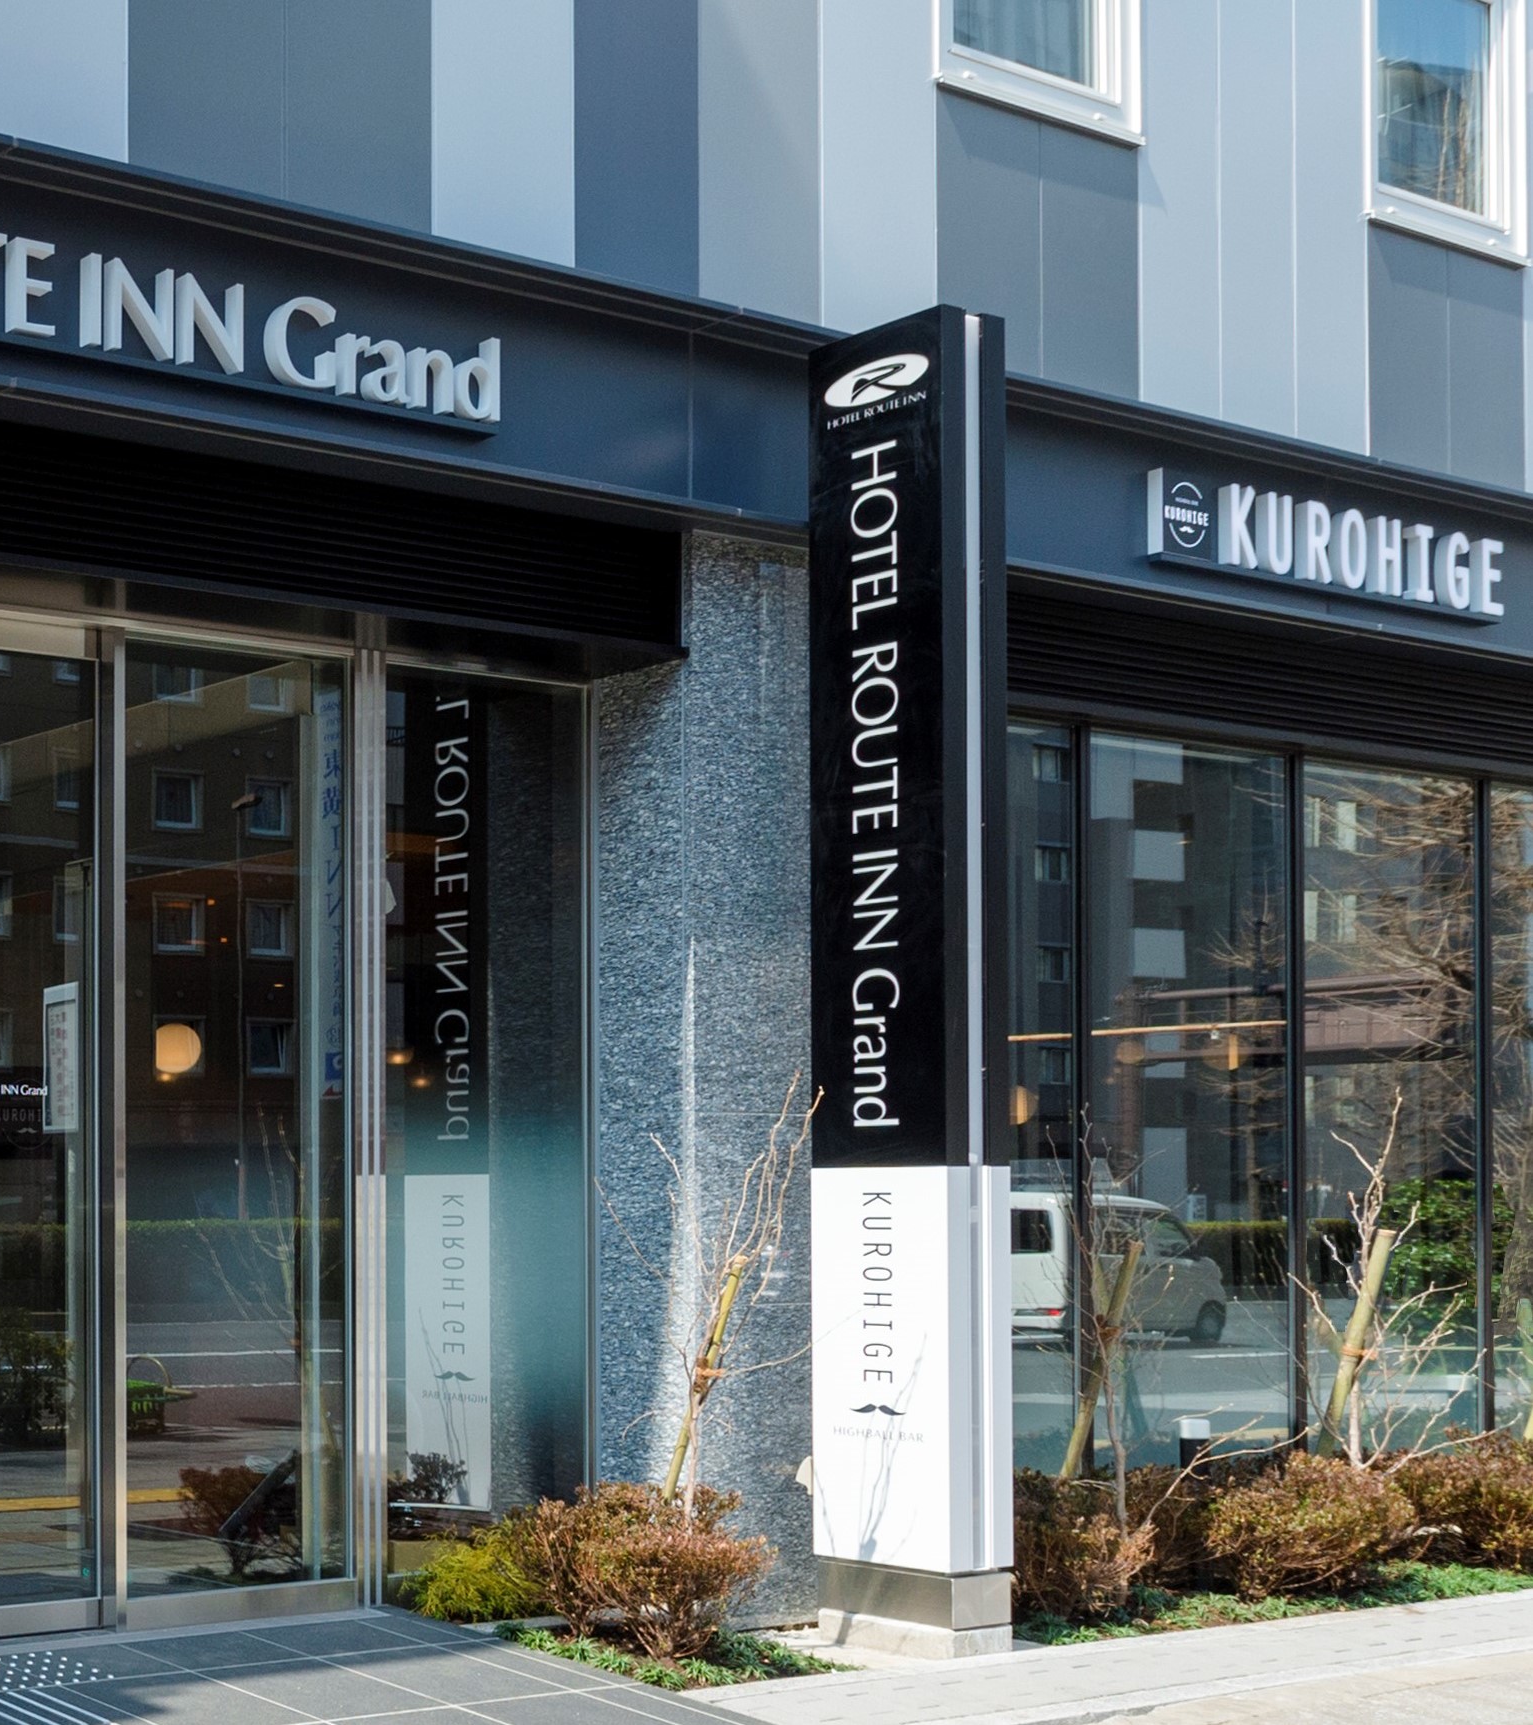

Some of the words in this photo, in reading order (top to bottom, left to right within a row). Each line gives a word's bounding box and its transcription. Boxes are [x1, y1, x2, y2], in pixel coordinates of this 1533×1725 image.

[79, 252, 244, 375] INN
[263, 296, 501, 423] Grand
[827, 411, 861, 430] HOTEL
[863, 398, 901, 418] ROUTE
[903, 390, 927, 406] INN
[850, 439, 898, 631] HOTEL
[1164, 505, 1209, 527] KUROHIGE
[1218, 483, 1504, 616] KUROHIGE
[851, 641, 899, 835] ROUTE
[852, 848, 899, 951] INN
[0, 1083, 19, 1096] INN
[20, 1084, 48, 1097] Grand
[852, 968, 900, 1128] Grand
[862, 1191, 893, 1384] KUROHIGE
[833, 1425, 894, 1441] HIGHBALL
[899, 1430, 925, 1443] BAR
